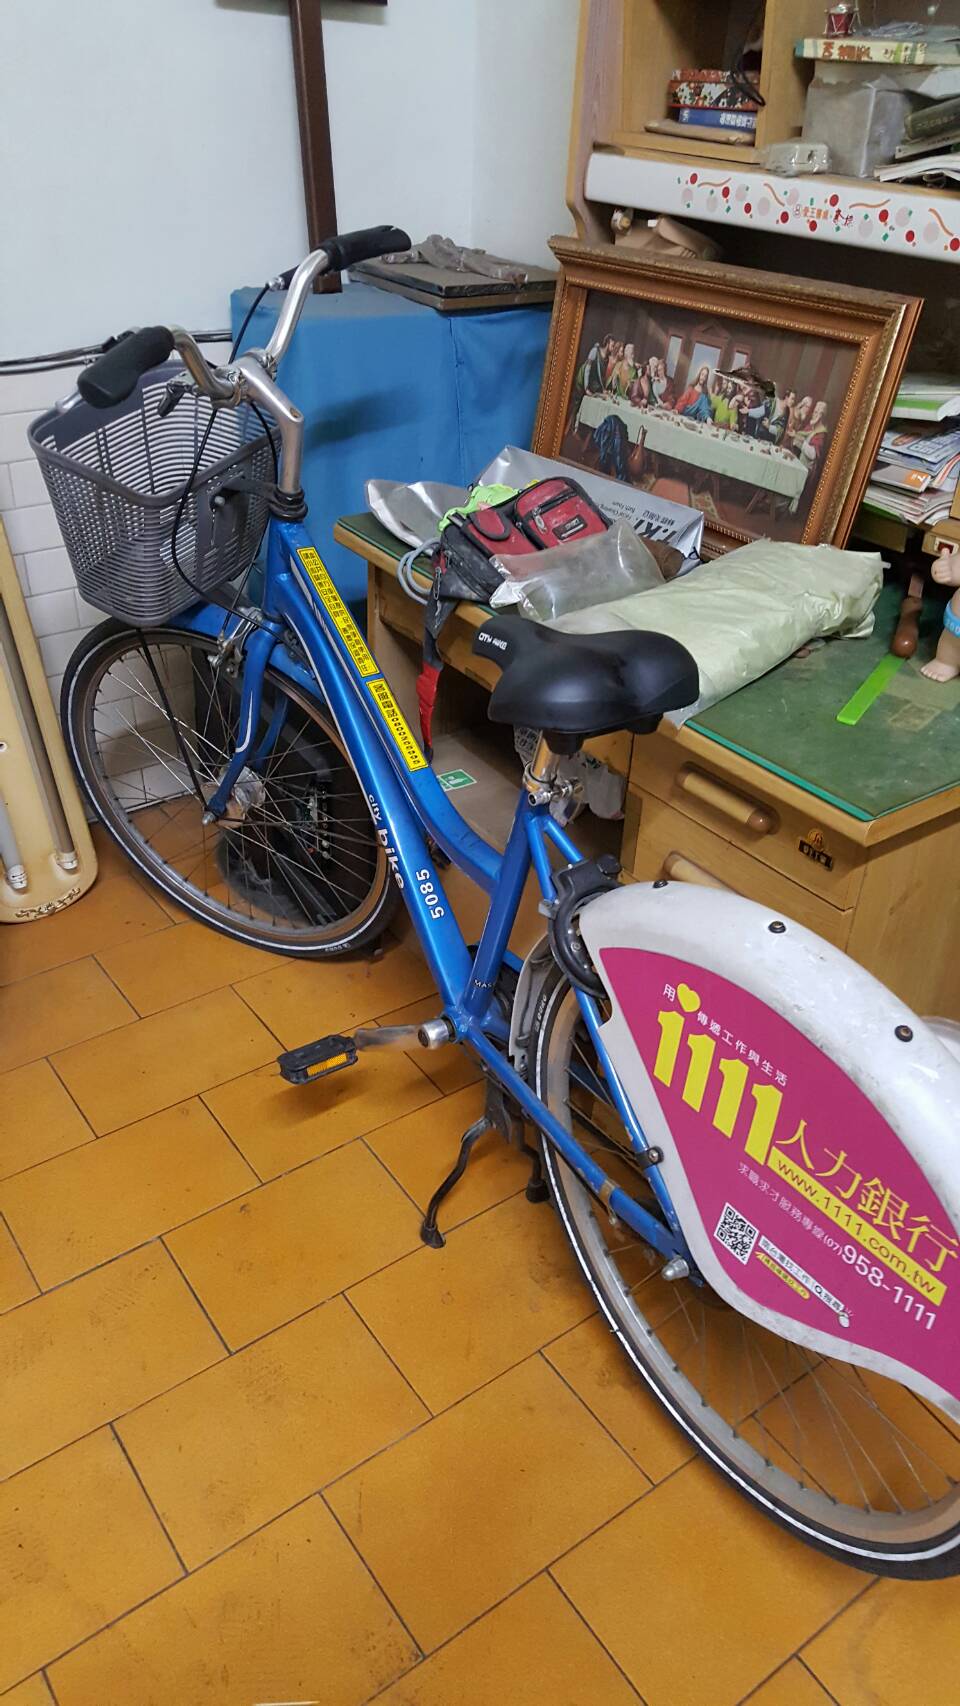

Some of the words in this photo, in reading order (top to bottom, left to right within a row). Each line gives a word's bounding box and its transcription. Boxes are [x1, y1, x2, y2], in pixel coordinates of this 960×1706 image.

[368, 794, 382, 821] city
[378, 829, 405, 889] bike
[416, 869, 444, 919] 5085
[663, 983, 676, 1002] 用
[654, 1010, 783, 1166] 1111
[776, 1120, 958, 1272] 人力銀行
[778, 1159, 937, 1295] www.1111.com.tw
